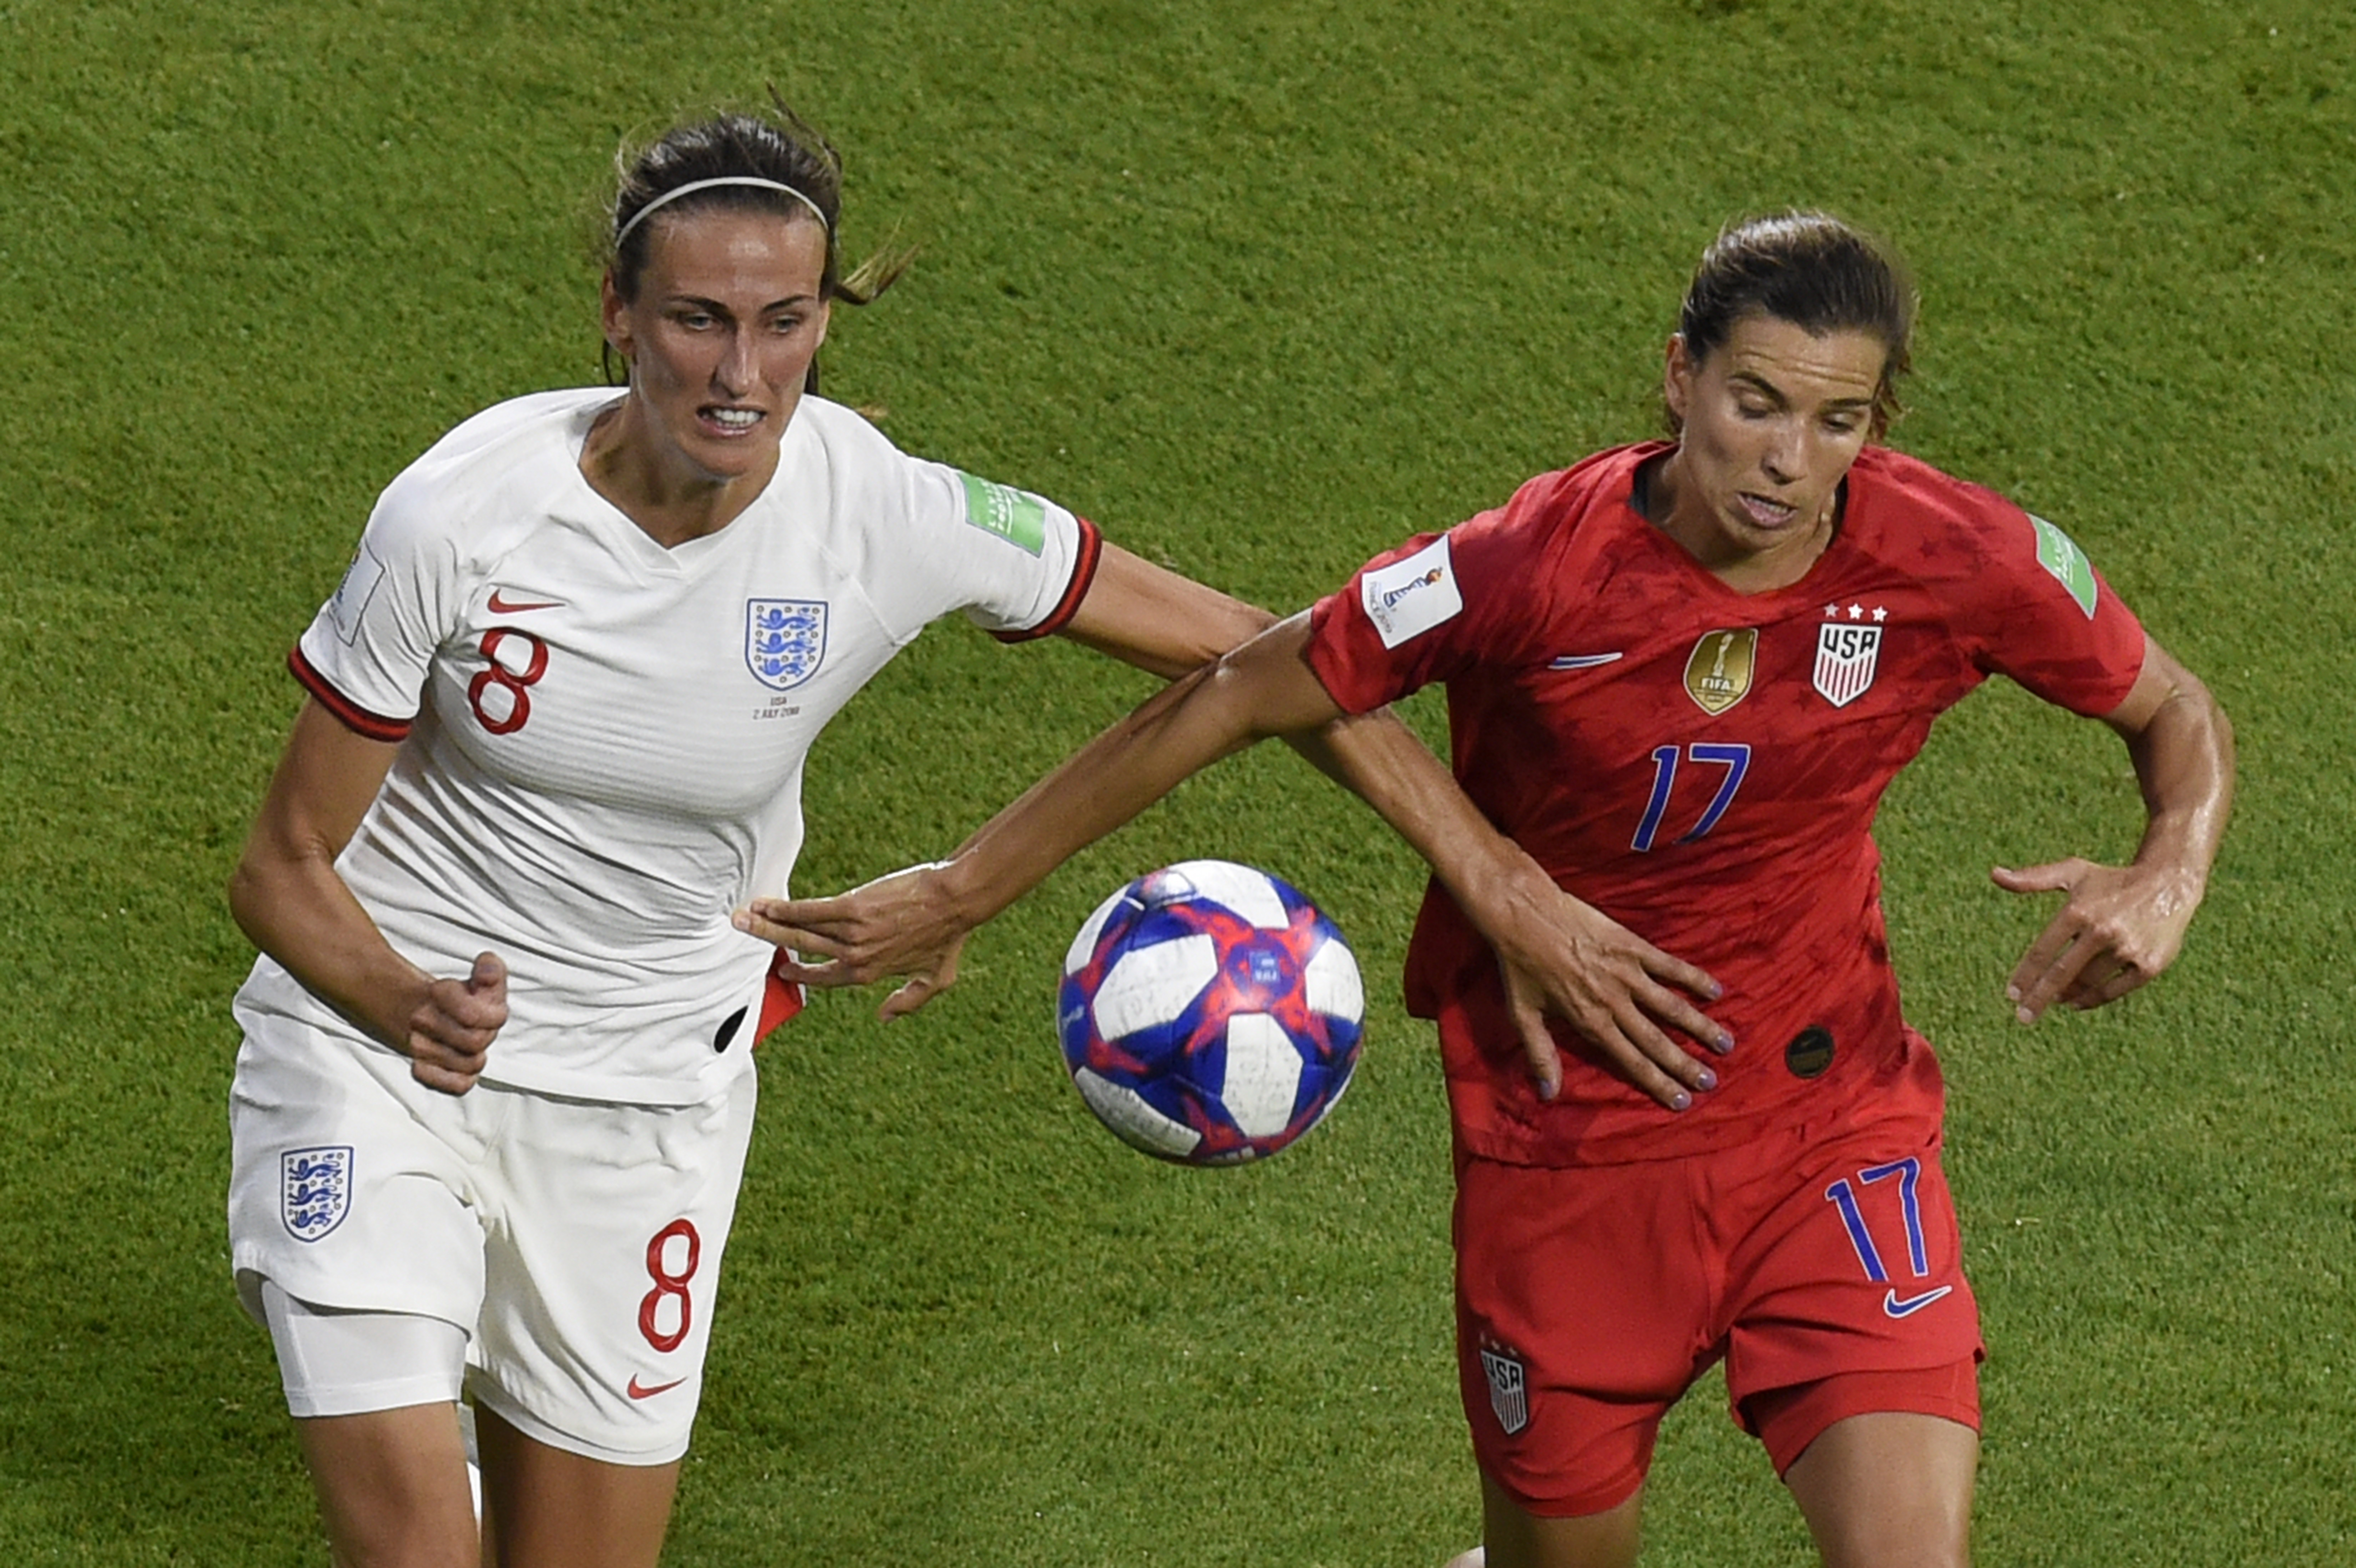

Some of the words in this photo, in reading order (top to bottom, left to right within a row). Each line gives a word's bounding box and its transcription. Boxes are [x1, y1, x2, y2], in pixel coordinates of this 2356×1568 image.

[468, 626, 549, 735] 8
[1702, 677, 1731, 690] FIFA
[1823, 628, 1876, 659] USA
[1631, 742, 1751, 852] 17
[1824, 1156, 1929, 1282] 17
[638, 1218, 701, 1353] 8
[1482, 1355, 1521, 1390] USA
